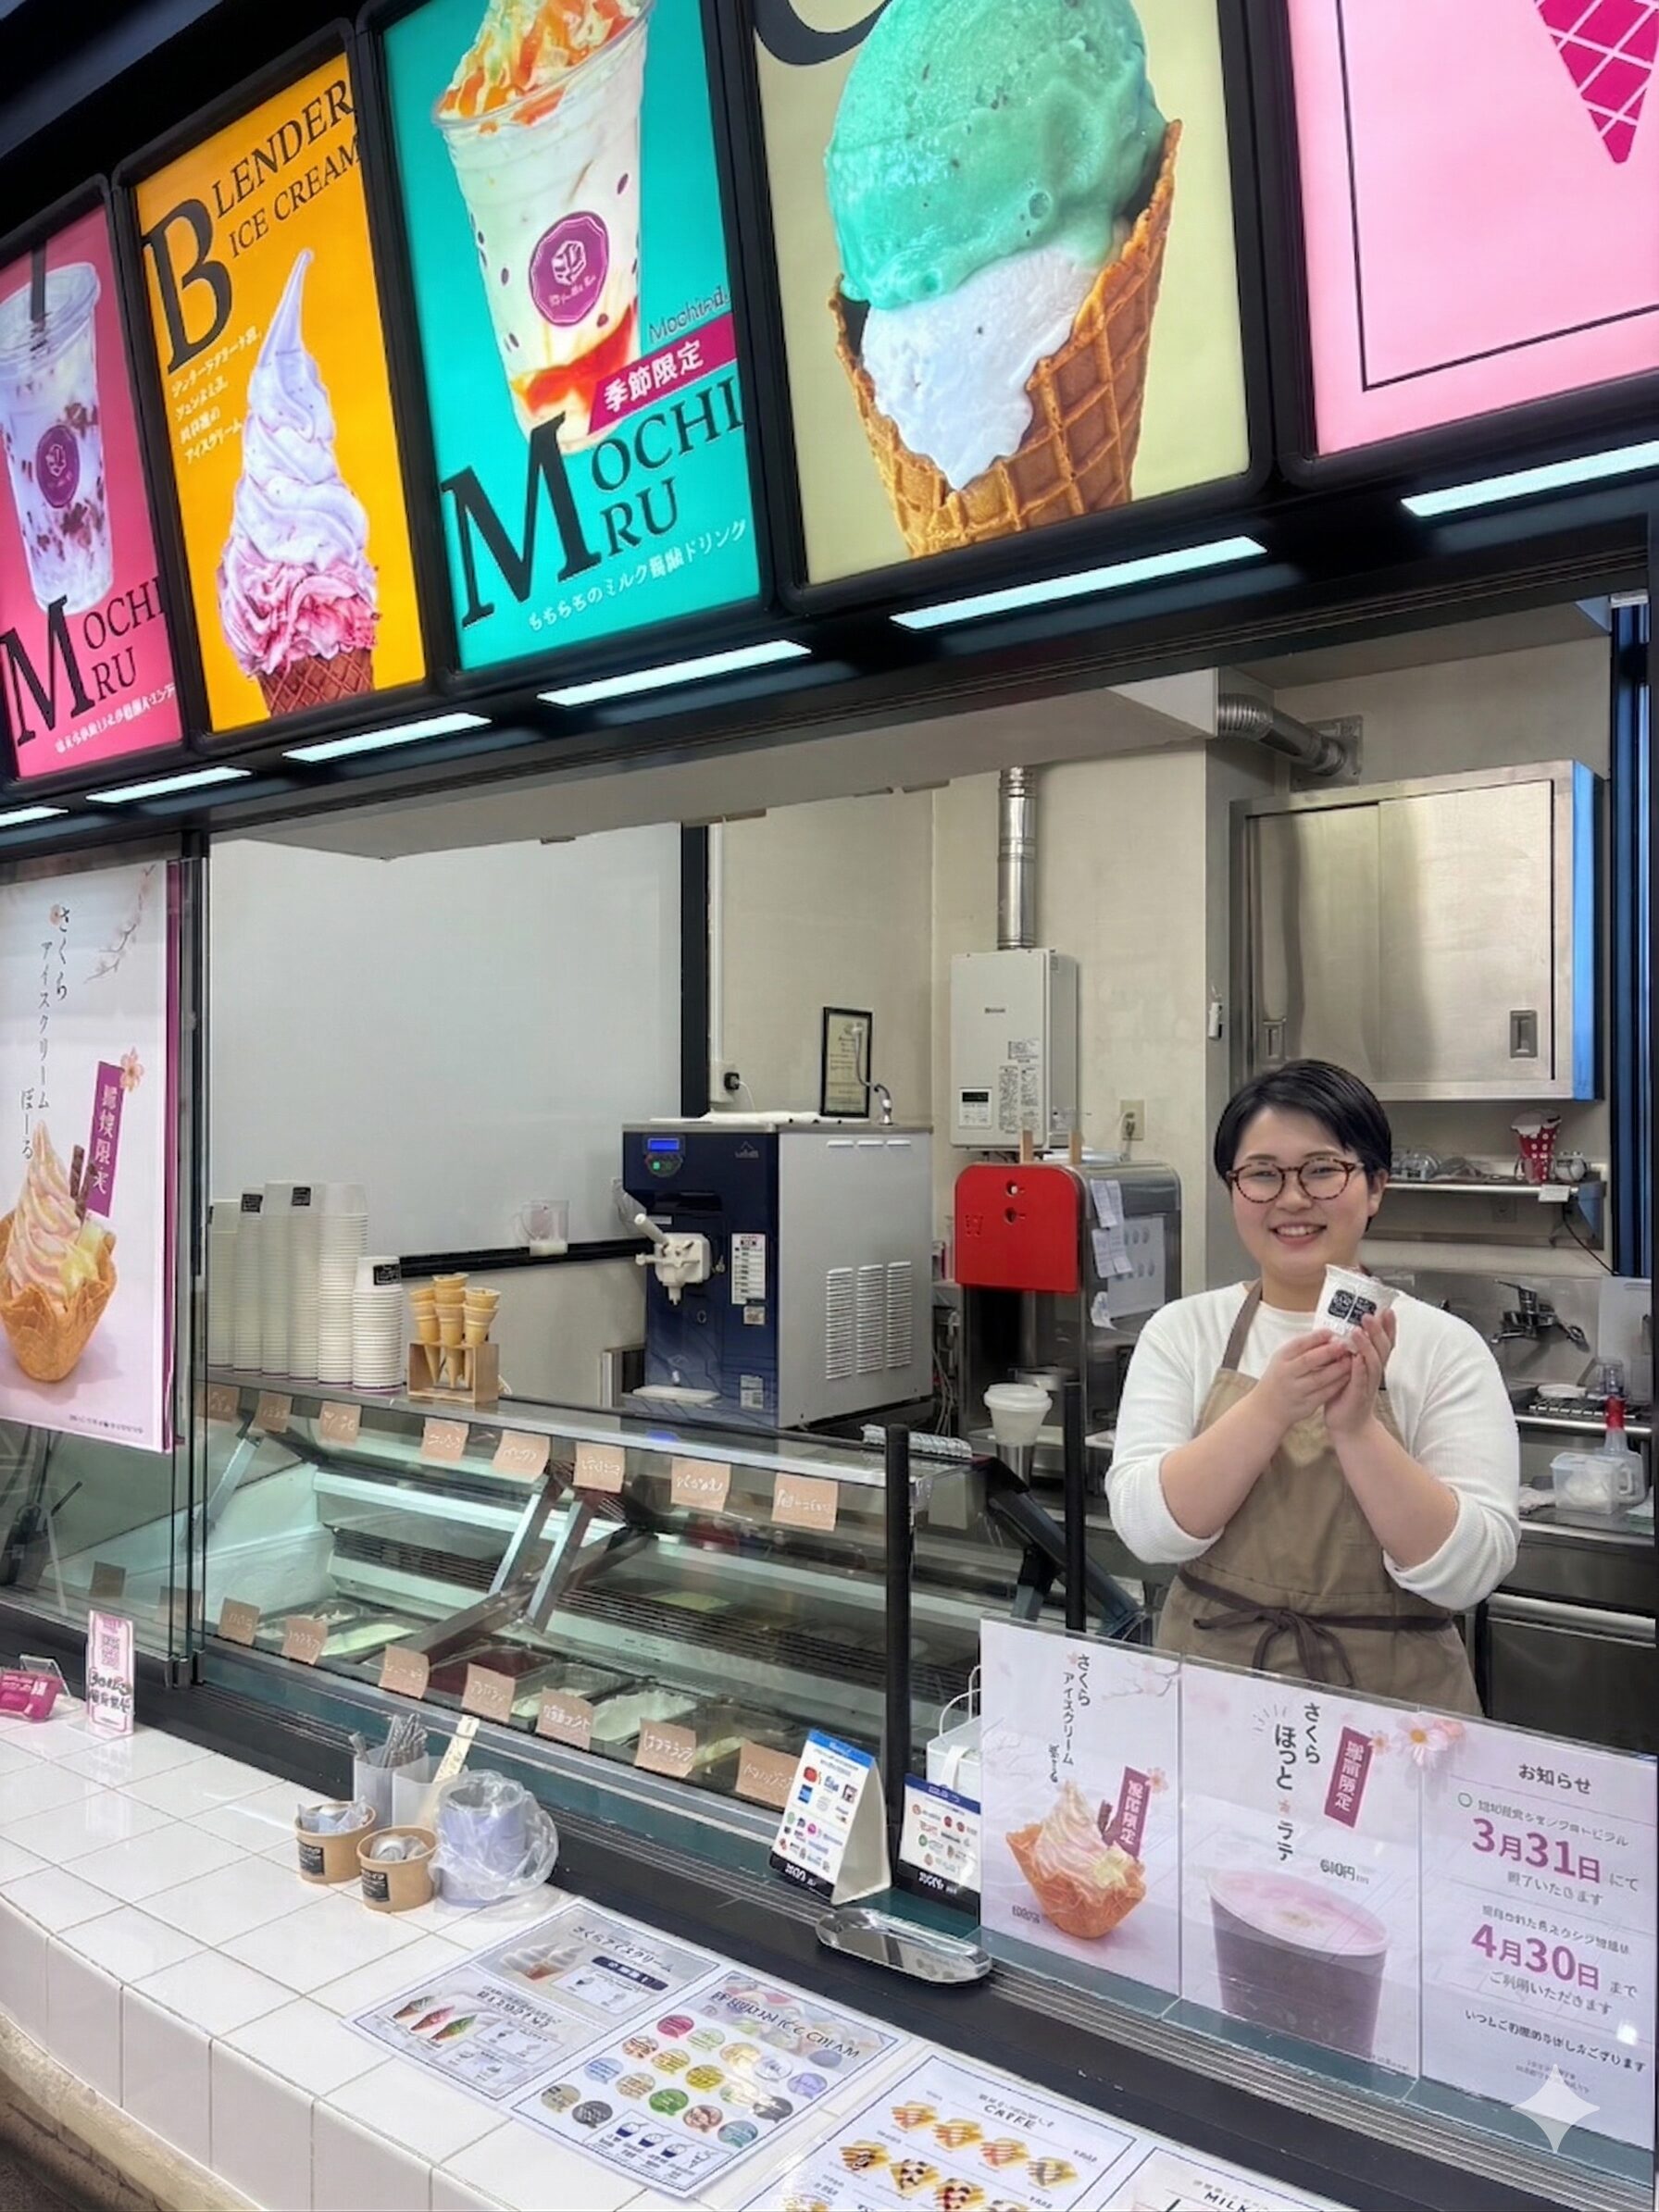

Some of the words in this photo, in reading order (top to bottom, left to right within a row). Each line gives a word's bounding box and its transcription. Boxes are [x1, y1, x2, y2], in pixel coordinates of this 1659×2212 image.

[141, 80, 356, 375] BLENDER
[229, 207, 269, 258] ICE
[273, 139, 361, 222] CREAM
[605, 339, 705, 413] 季節限定
[441, 374, 746, 629] MOCHI
[91, 646, 138, 702] RU
[56, 906, 70, 1000] さくら
[37, 940, 51, 1110] アイスクリーム
[1077, 1653, 1091, 1707] さくら
[1062, 1671, 1075, 1766] アイスクリーム
[1274, 1722, 1297, 1791] ほっと
[1304, 1702, 1322, 1765] さくら
[1518, 1762, 1592, 1796] お知らせ
[1471, 1817, 1602, 1884] 3月31日
[1609, 1872, 1640, 1892] にて
[1470, 1922, 1600, 1991] 4月30日
[1609, 1980, 1638, 1999] まで
